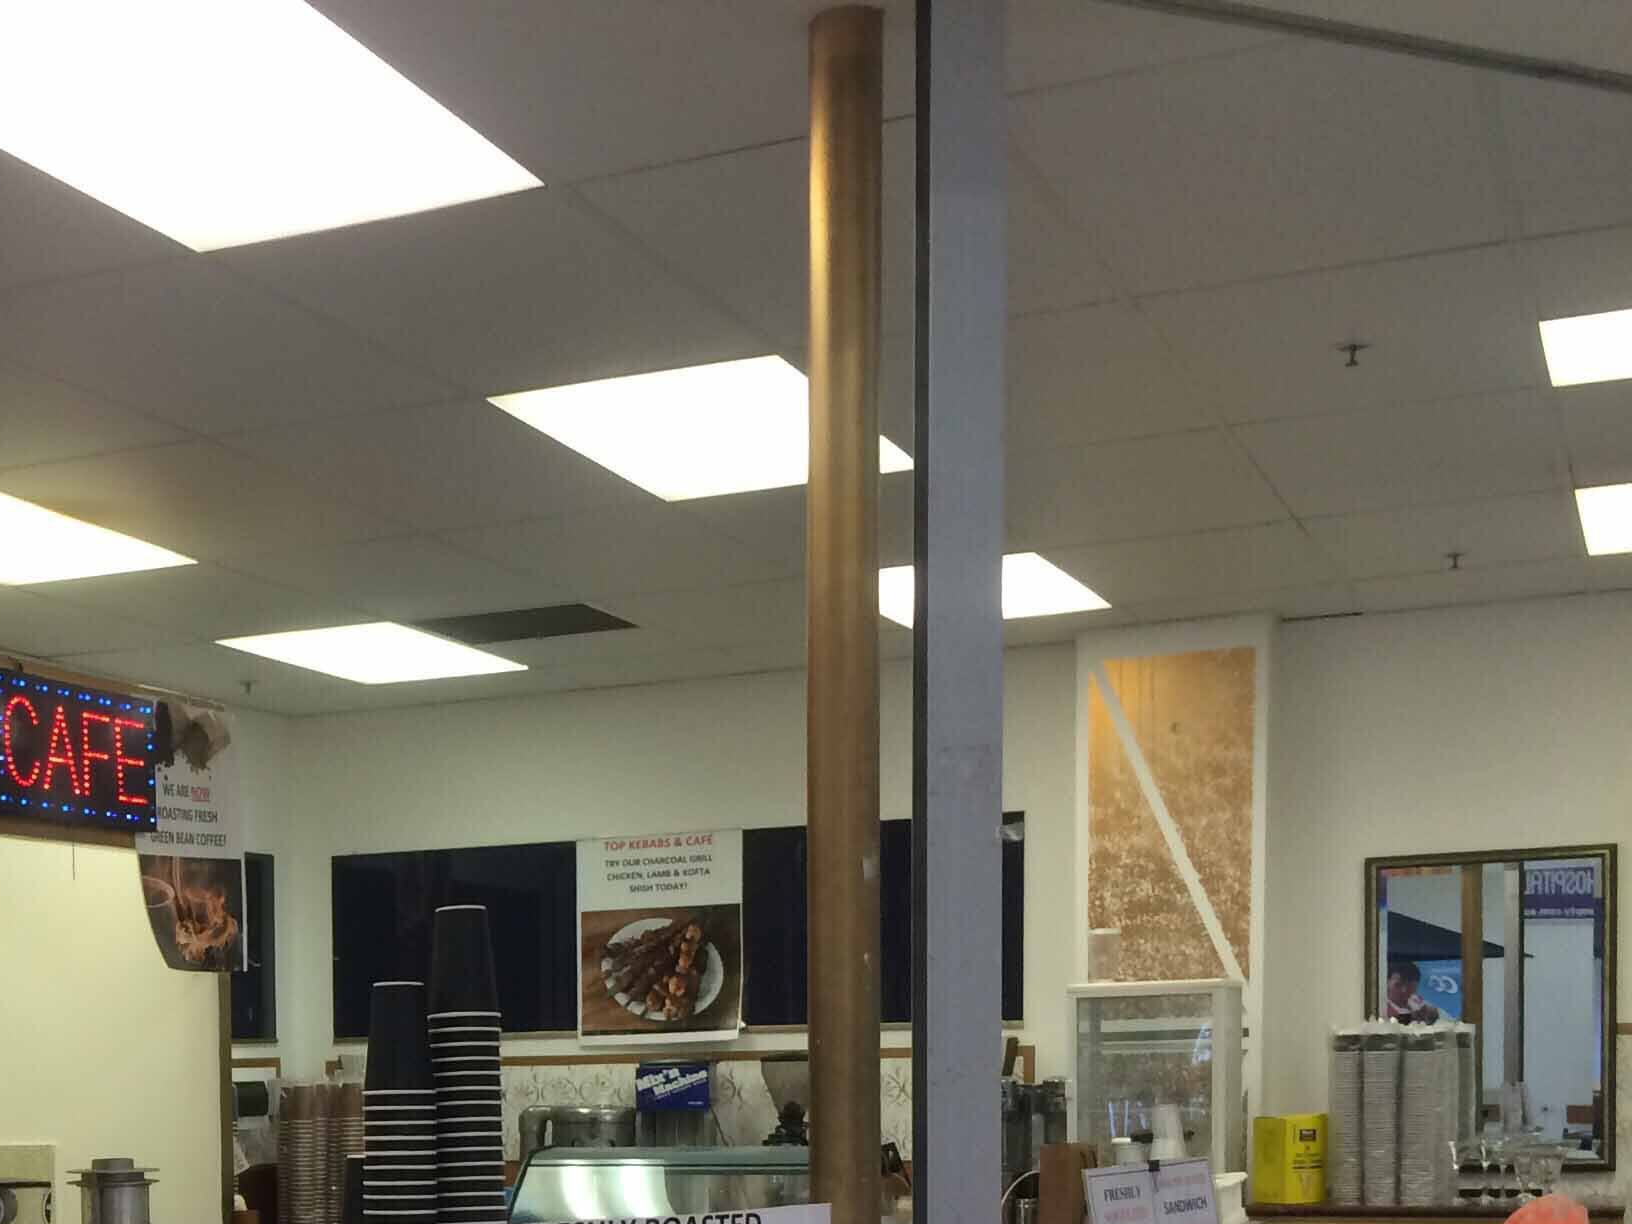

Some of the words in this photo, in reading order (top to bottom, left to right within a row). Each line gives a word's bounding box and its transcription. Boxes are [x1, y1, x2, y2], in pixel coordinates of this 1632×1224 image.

[3, 695, 149, 804] CAFE
[162, 783, 174, 797] WE
[176, 783, 189, 797] ARE
[157, 806, 193, 821] ROASTING
[195, 809, 218, 823] FRESH
[150, 831, 174, 844] GREEN
[176, 832, 194, 844] BEAN
[604, 840, 626, 851] TOP
[629, 837, 671, 850] KEBABS
[674, 836, 682, 847] &
[605, 859, 619, 868] TRY
[622, 858, 640, 867] OUR
[643, 855, 687, 866] CHARCOAL
[689, 854, 712, 863] GRILL
[647, 869, 671, 879] LAMB
[682, 867, 710, 876] KOFTA
[630, 883, 653, 893] SHISH
[1103, 1185, 1141, 1202] FRESHLY
[1163, 1195, 1208, 1215] SANDWICH
